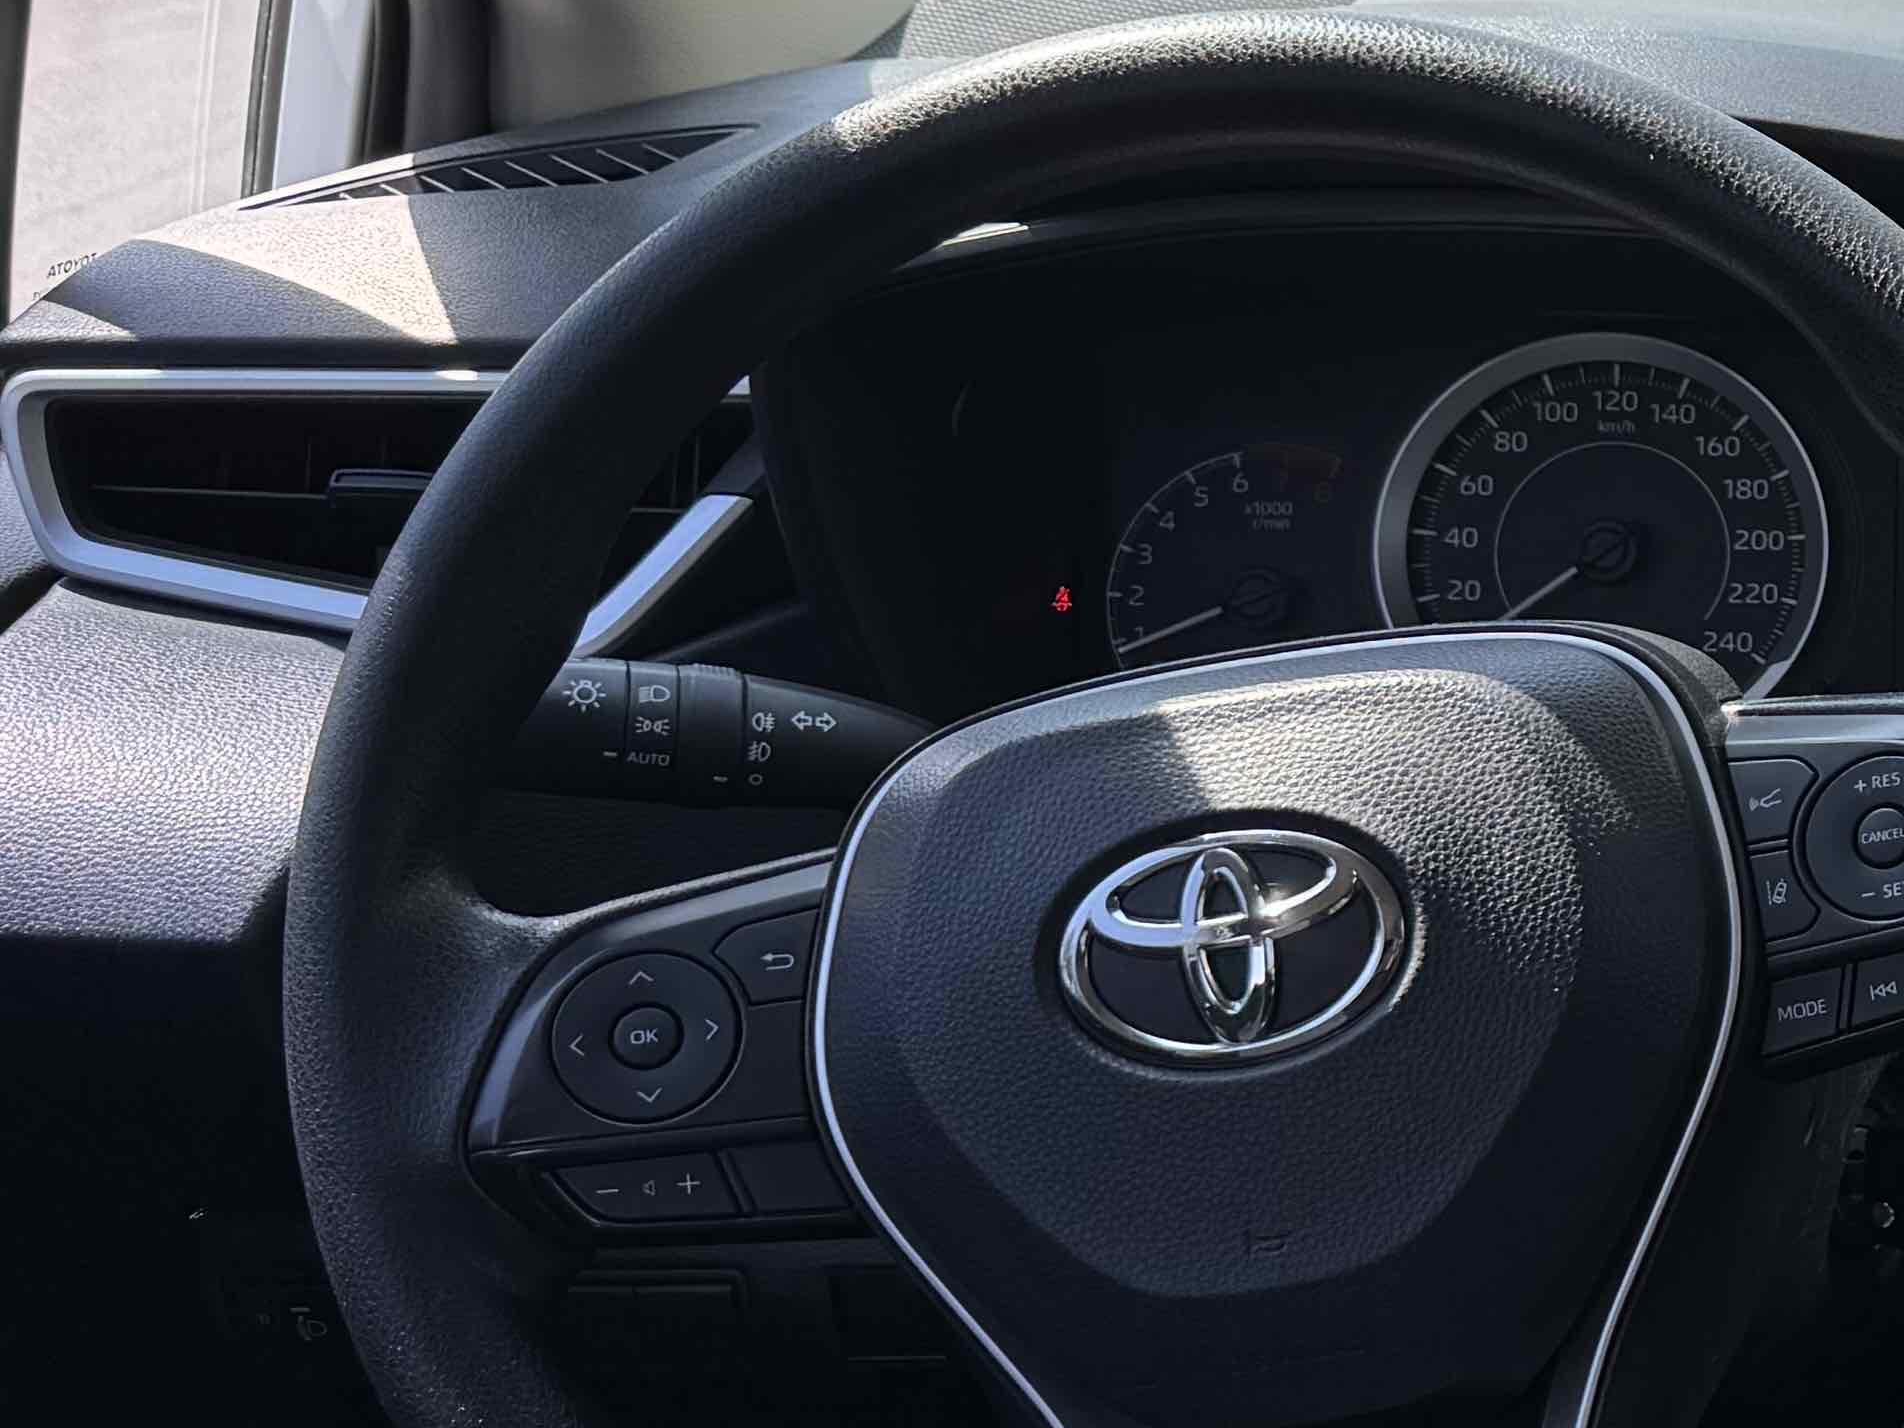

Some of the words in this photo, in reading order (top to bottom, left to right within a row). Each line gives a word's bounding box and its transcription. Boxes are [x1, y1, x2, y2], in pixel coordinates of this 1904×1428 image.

[1532, 400, 1579, 425] 100
[1593, 389, 1640, 414] 120
[1649, 402, 1697, 426] 140
[1493, 429, 1529, 454] 80
[1695, 434, 1742, 459] 160
[1232, 473, 1249, 493] 6
[1458, 473, 1495, 498] 60
[1723, 476, 1770, 501] 180
[1193, 487, 1209, 507] 5
[1159, 511, 1176, 531] 4
[1444, 526, 1480, 550] 40
[1733, 528, 1786, 553] 200
[1137, 545, 1153, 565] 3
[1128, 586, 1145, 607] 2
[1446, 577, 1482, 603] 20
[1728, 581, 1779, 606] 220
[1703, 629, 1755, 654] 240
[627, 750, 671, 767] AUTO
[1871, 771, 1901, 790] RES
[1777, 999, 1828, 1022] MODE
[630, 1027, 659, 1046] OK
